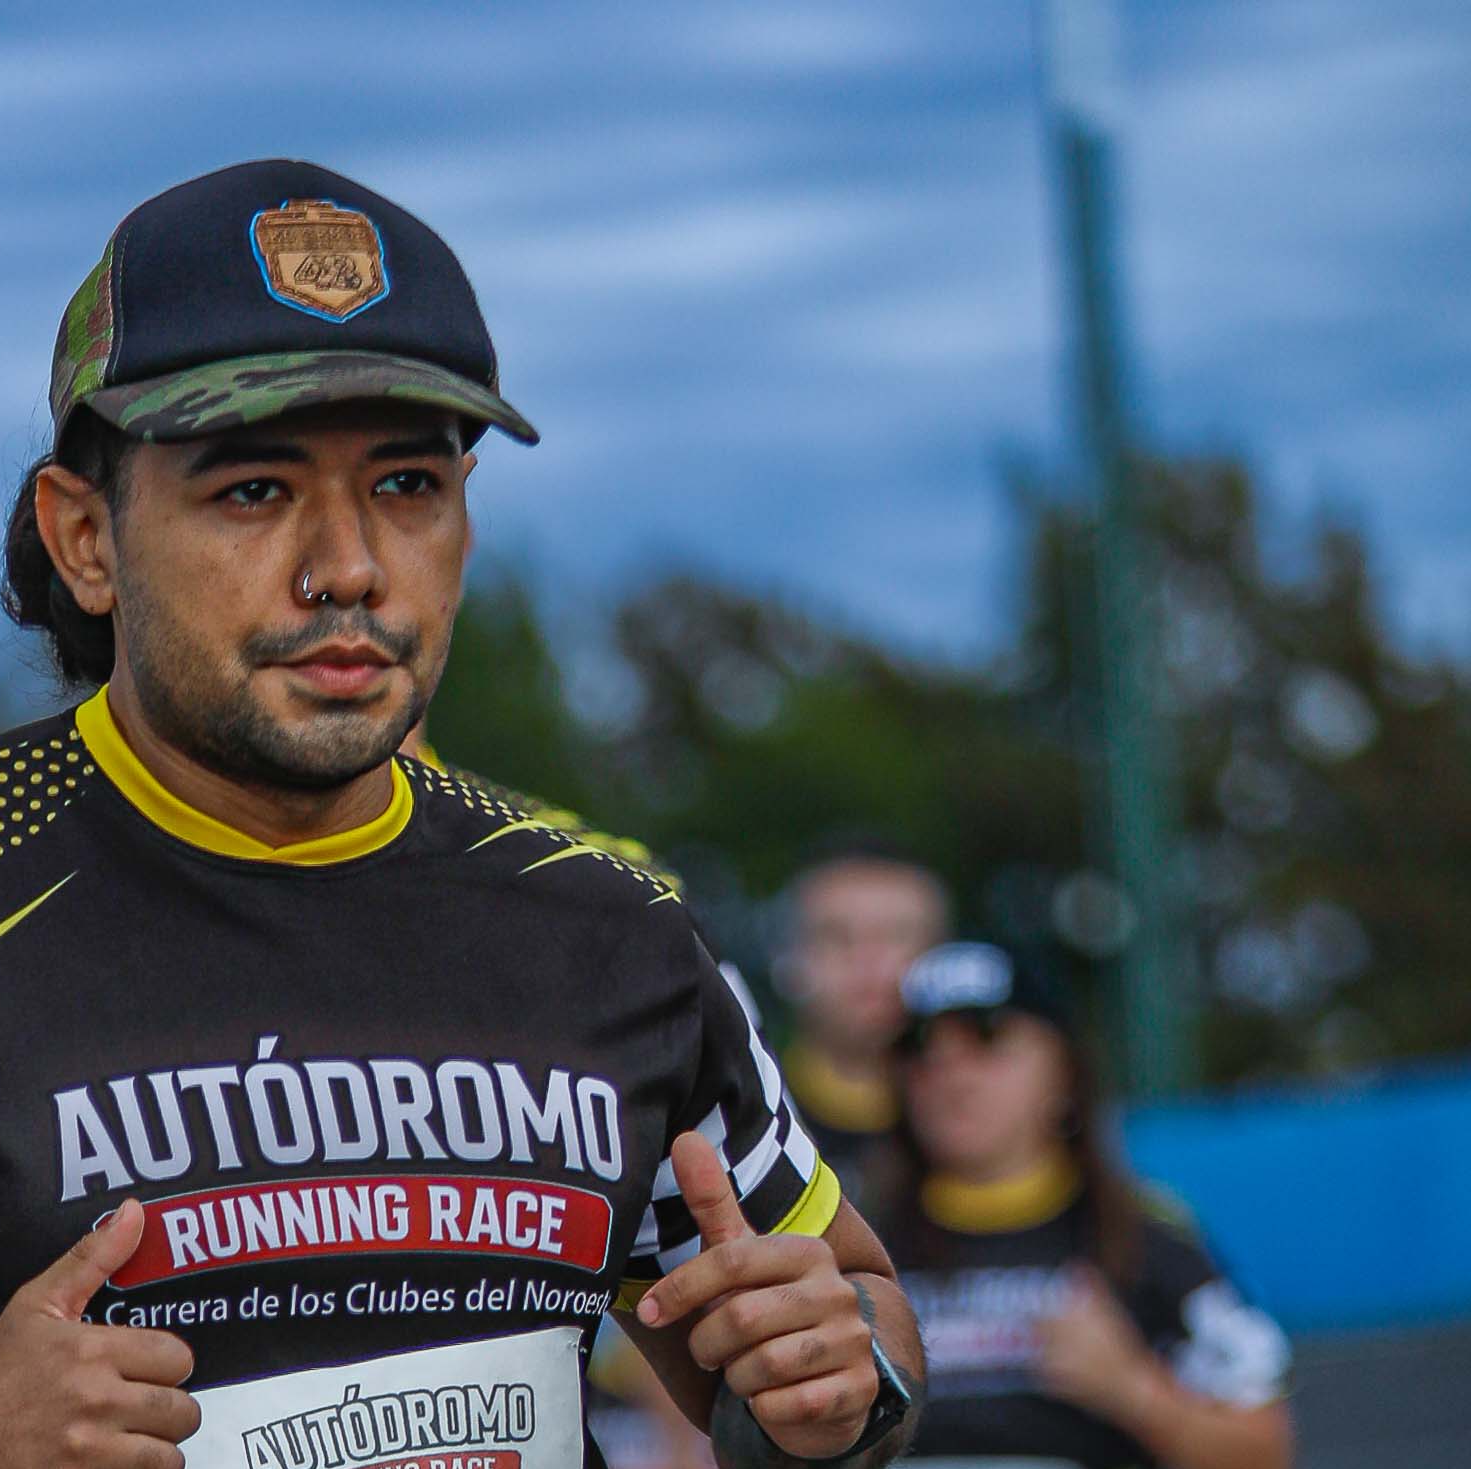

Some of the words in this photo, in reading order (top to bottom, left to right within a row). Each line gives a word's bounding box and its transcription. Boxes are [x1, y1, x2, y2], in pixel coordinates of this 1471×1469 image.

[53, 1035, 623, 1202] AUTÓDROMO
[162, 1184, 411, 1269] RUNNING
[428, 1185, 567, 1254] RACE
[105, 1298, 228, 1328] Carrera
[239, 1287, 279, 1320] de
[290, 1283, 335, 1316] los
[346, 1281, 455, 1315] Clubes
[464, 1278, 516, 1311] del
